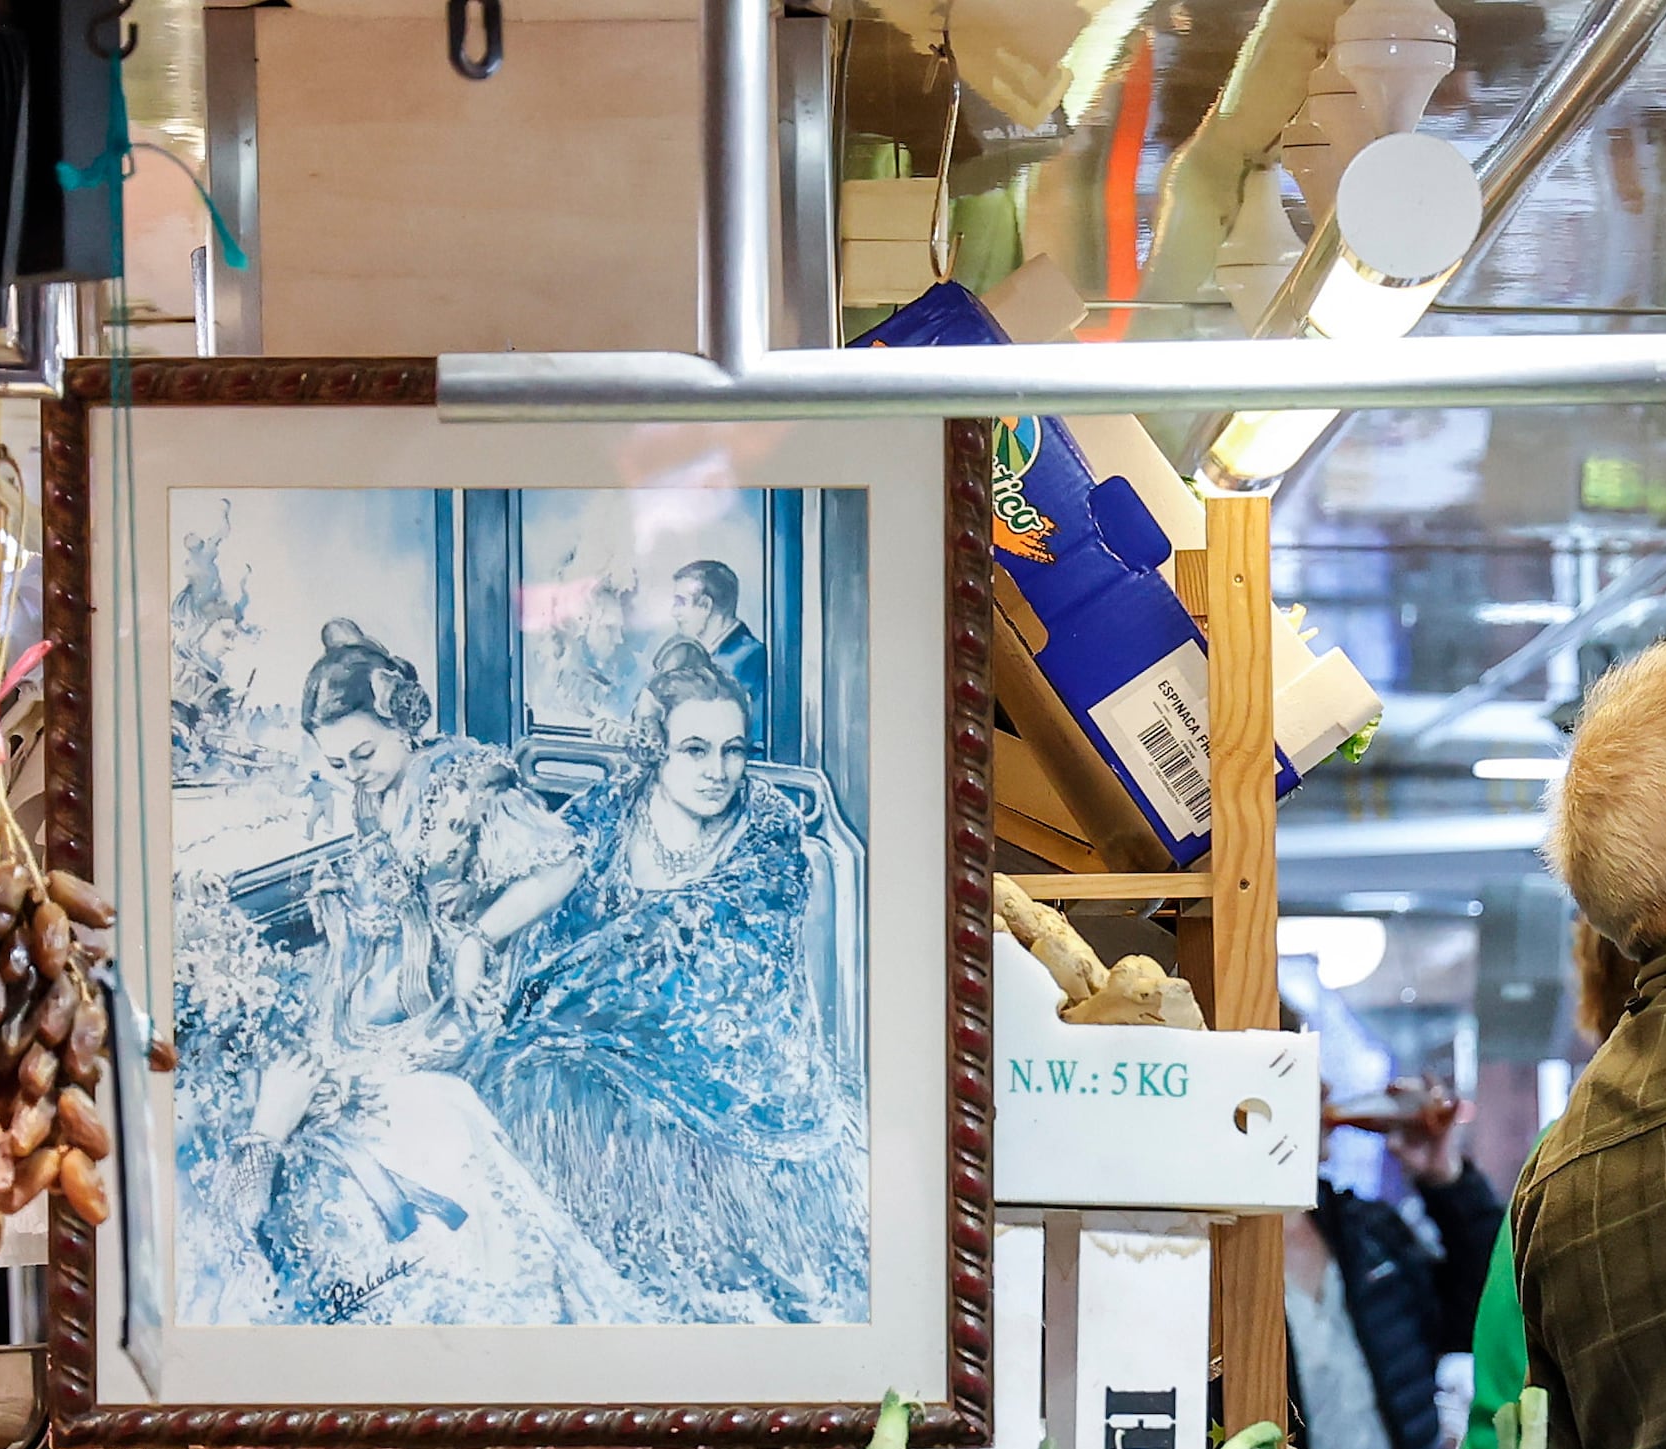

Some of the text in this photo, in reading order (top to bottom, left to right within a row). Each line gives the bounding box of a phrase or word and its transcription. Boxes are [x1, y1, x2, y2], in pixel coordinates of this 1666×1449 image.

[1156, 679, 1201, 736] ESPINACA
[1009, 1057, 1190, 1098] N.W.: 5 KG
